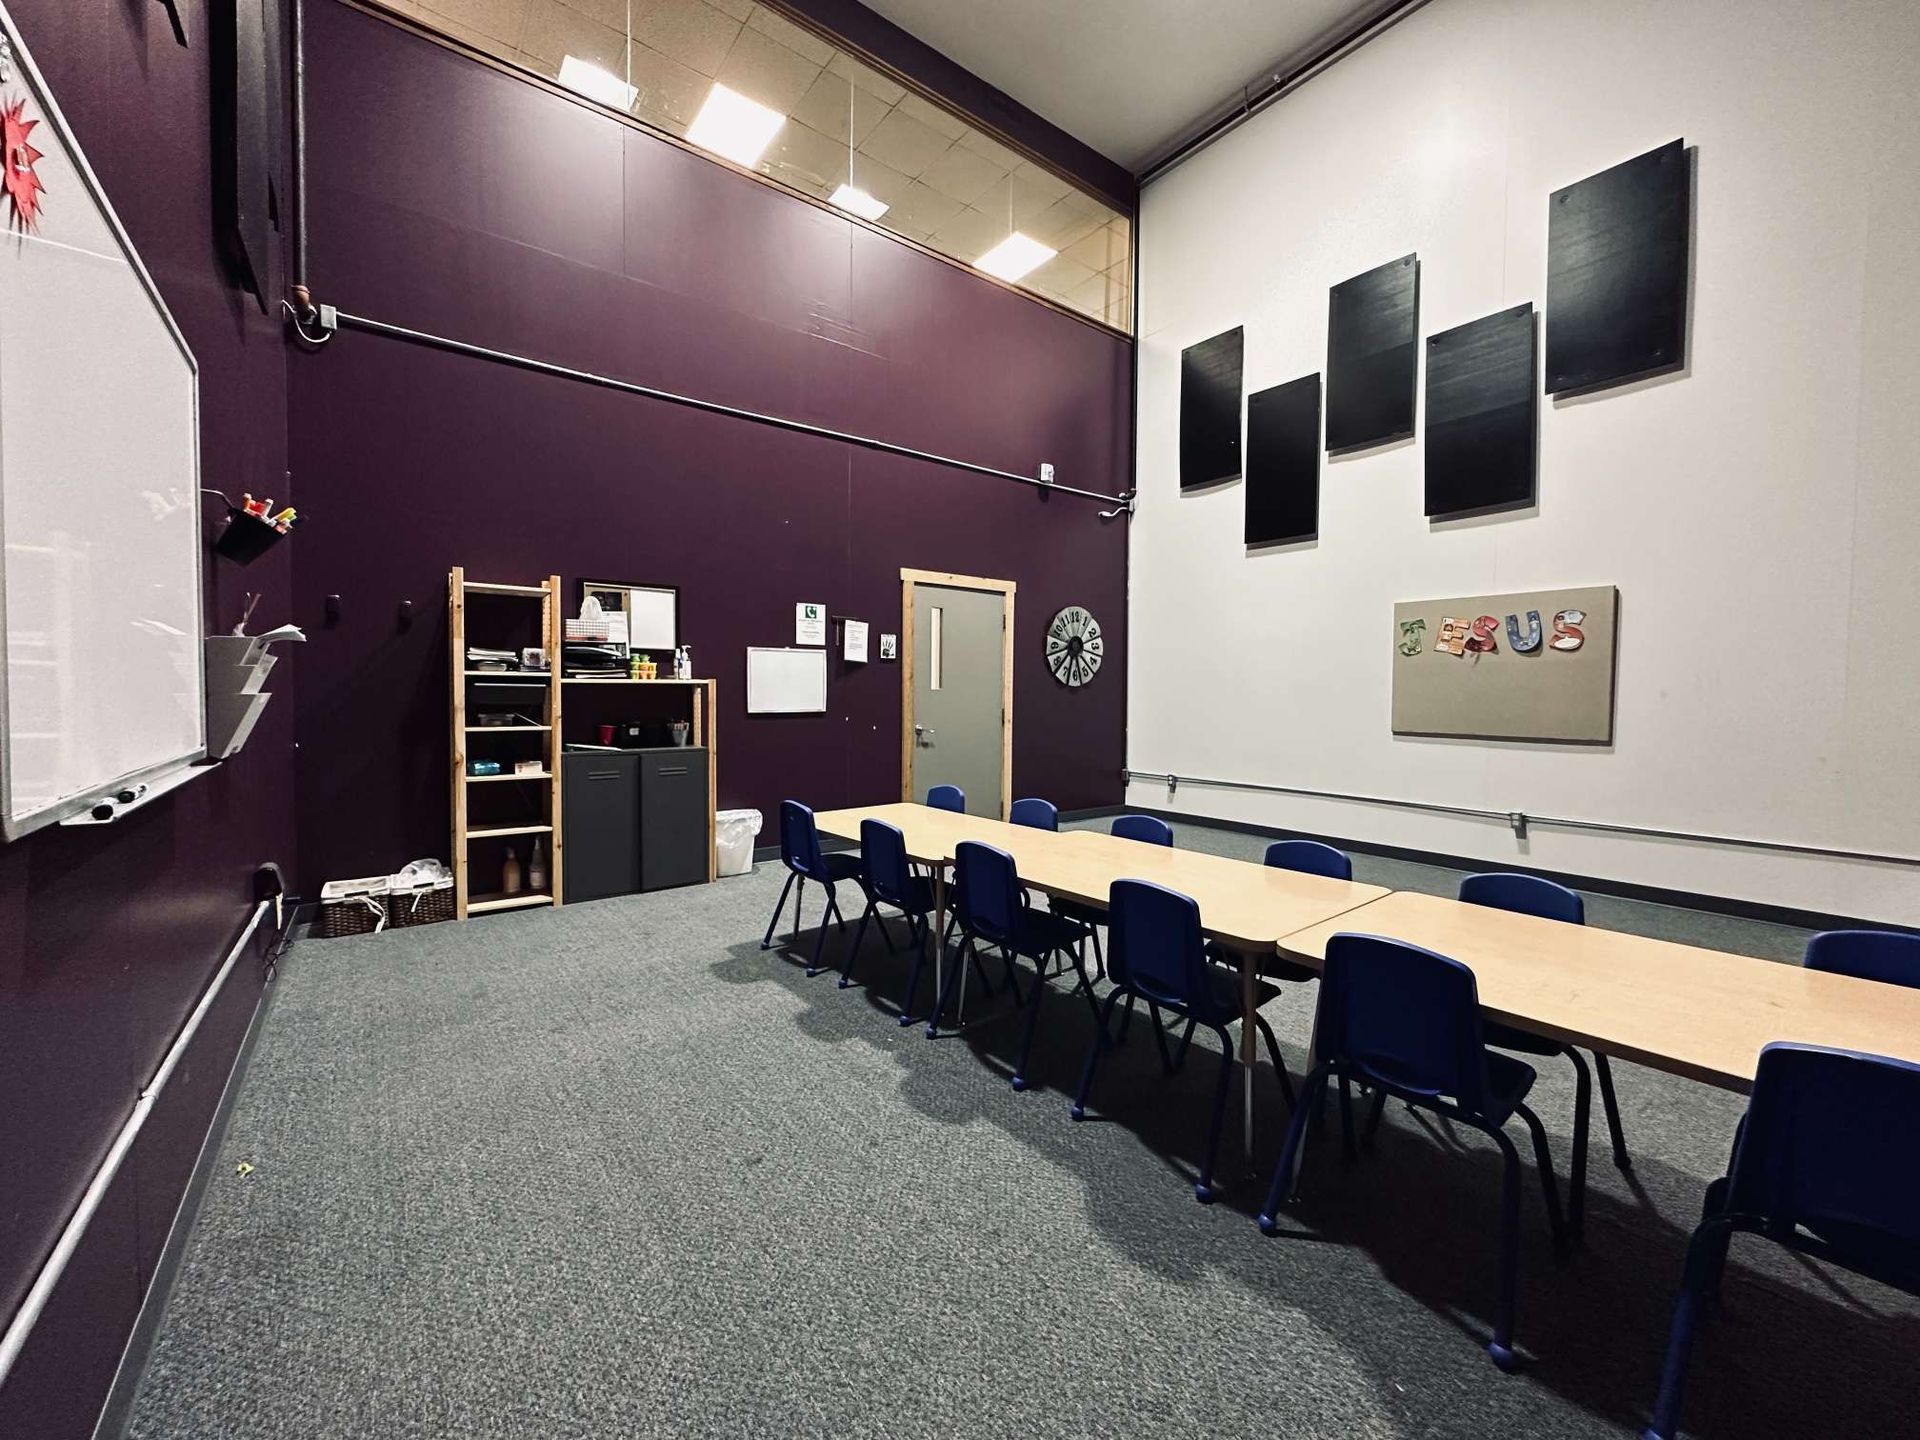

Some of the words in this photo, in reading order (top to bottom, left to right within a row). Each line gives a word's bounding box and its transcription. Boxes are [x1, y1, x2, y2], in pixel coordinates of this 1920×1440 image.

[1071, 611, 1080, 623] 12
[1082, 616, 1087, 627] 1
[1054, 625, 1063, 636] 10
[1088, 628, 1097, 637] 2
[1398, 609, 1587, 657] JESUS
[1091, 642, 1099, 650] 3
[1053, 656, 1061, 665] 8
[1090, 656, 1097, 665] 4
[1082, 666, 1089, 677] 5
